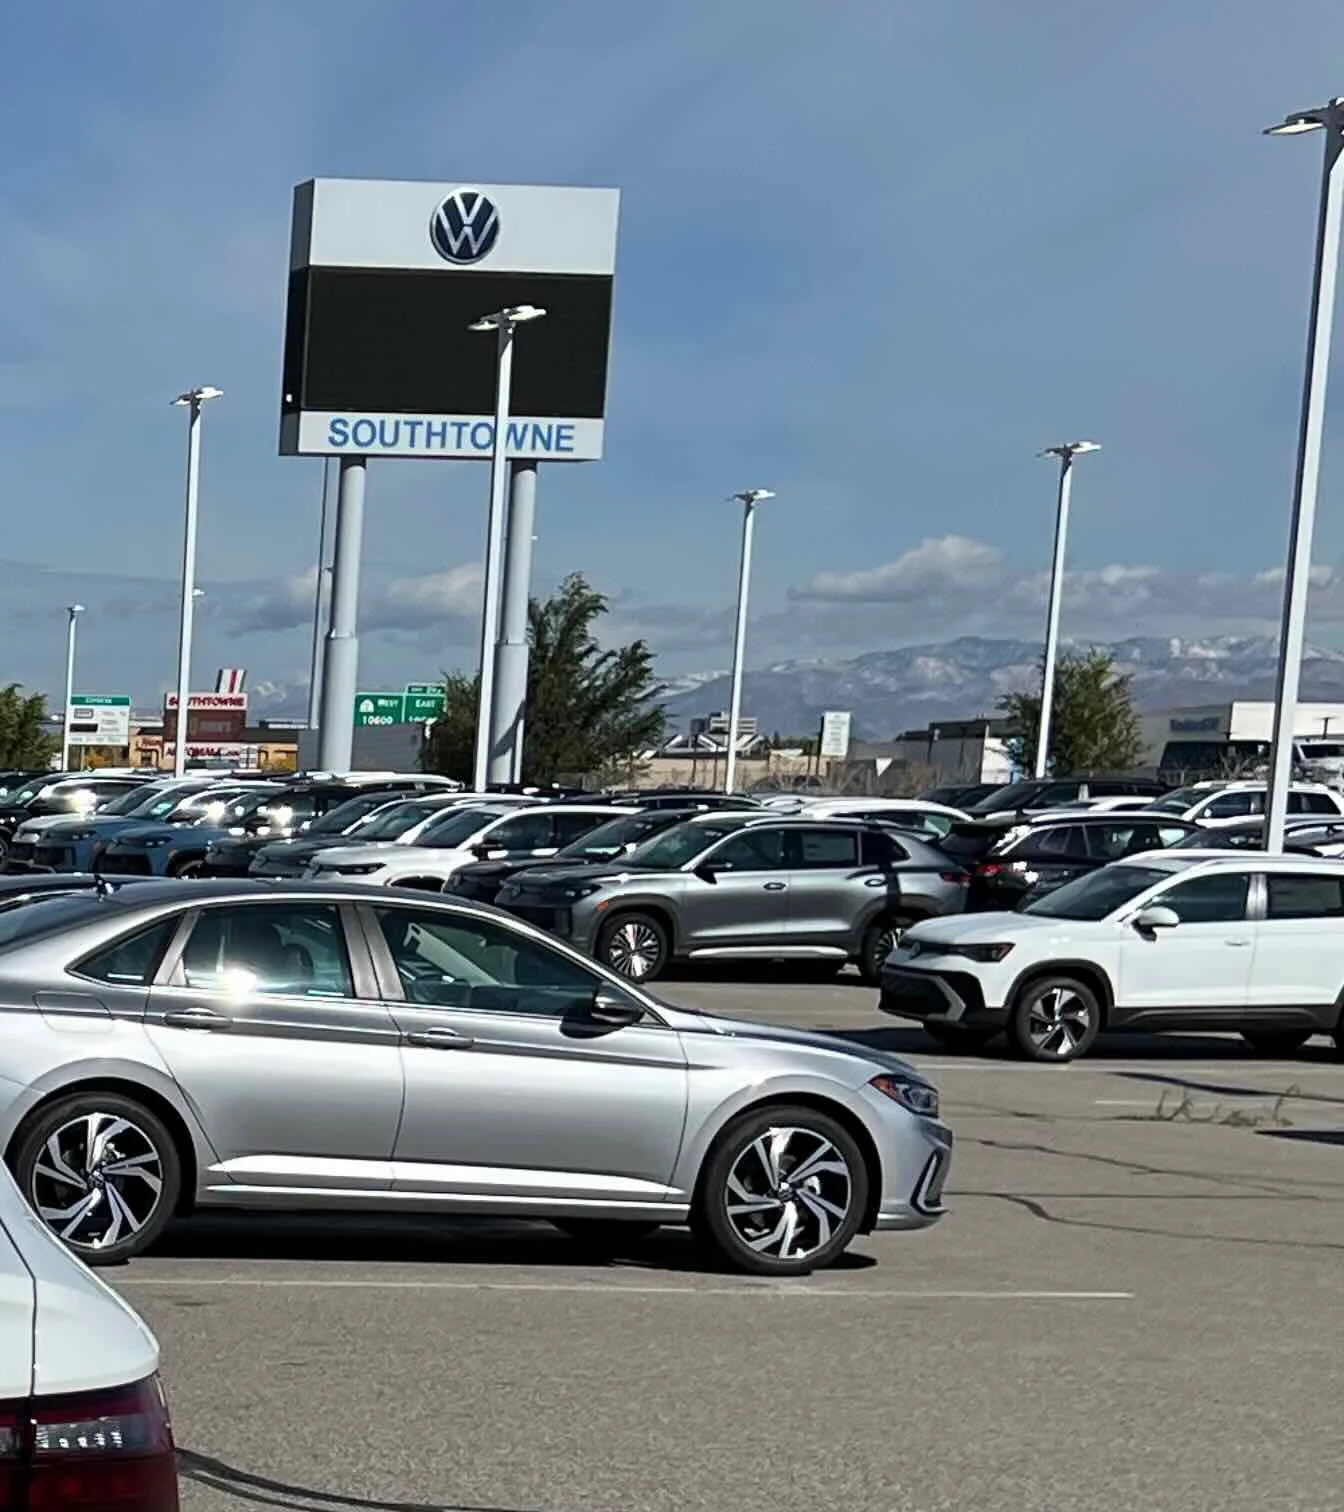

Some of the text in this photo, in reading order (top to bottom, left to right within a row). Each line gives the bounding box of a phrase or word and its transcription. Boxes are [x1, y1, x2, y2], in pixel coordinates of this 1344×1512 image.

[432, 188, 499, 262] VW
[328, 418, 575, 452] SOUTHTOWNE
[169, 696, 244, 706] STHTOWNE
